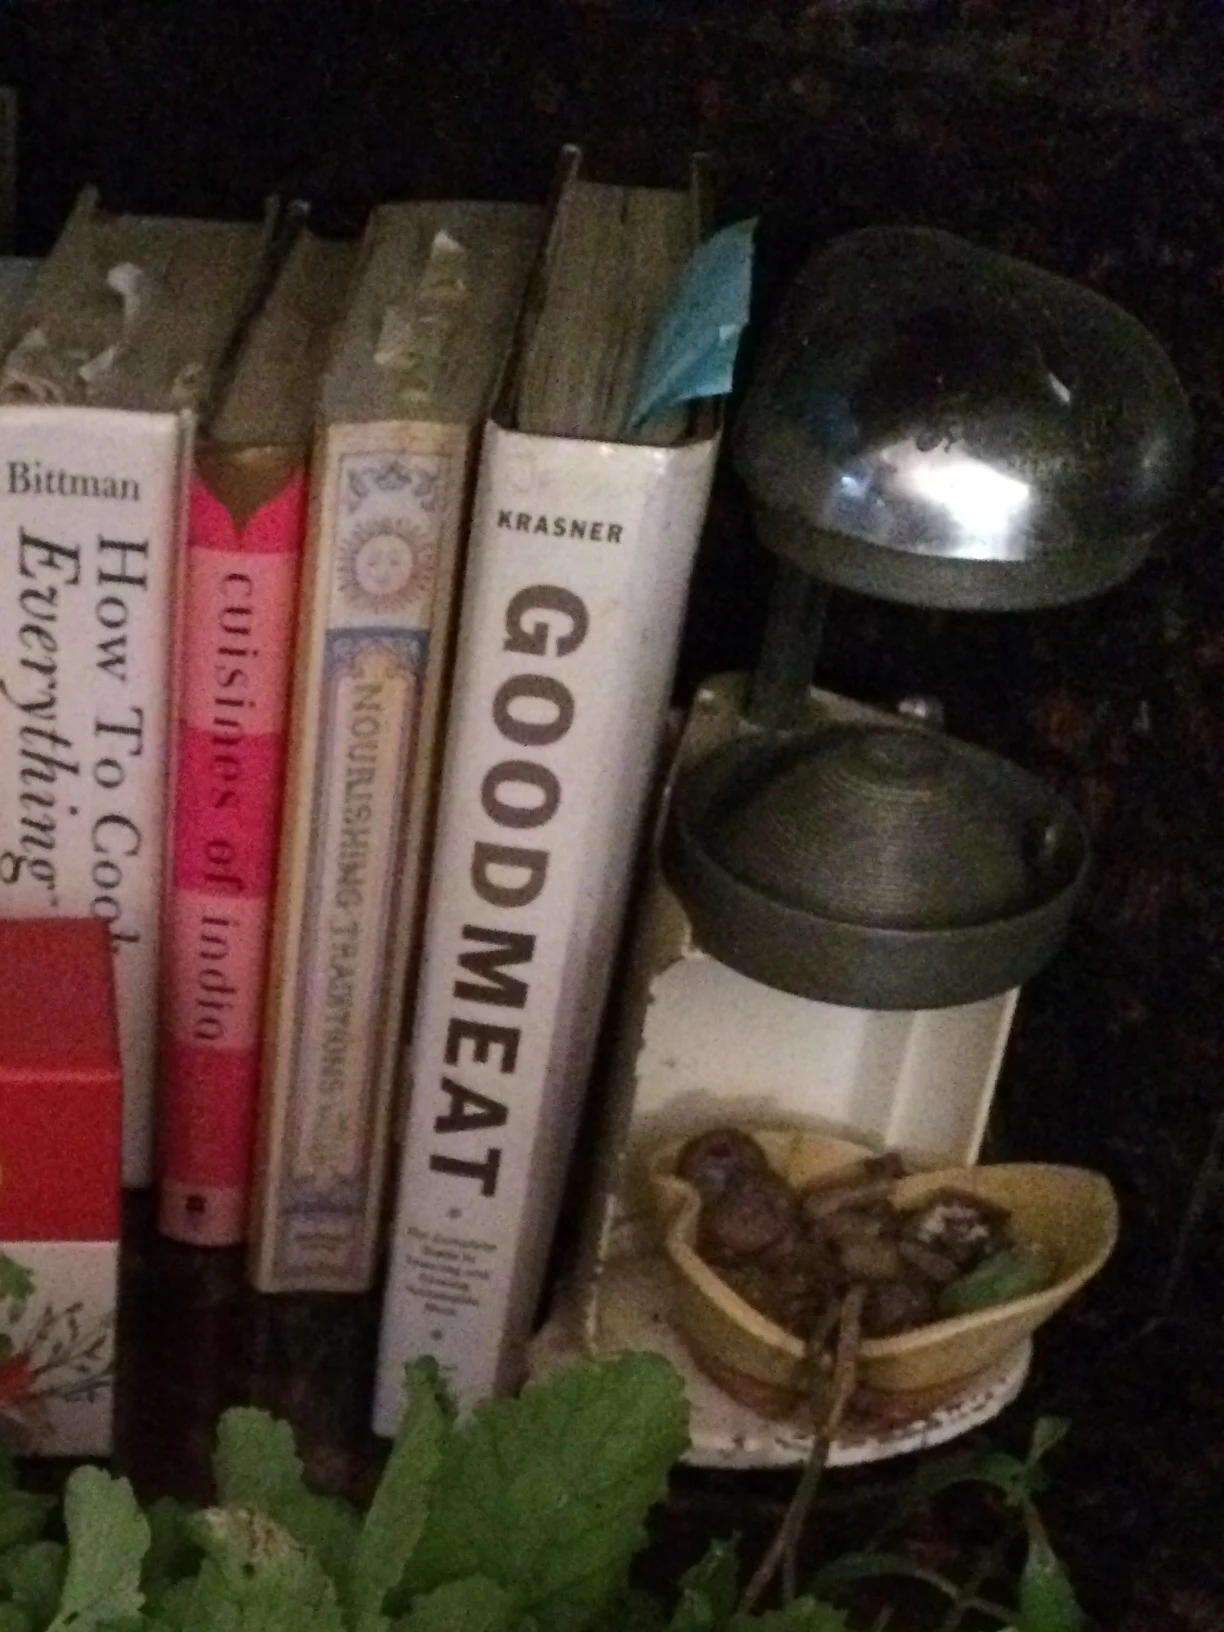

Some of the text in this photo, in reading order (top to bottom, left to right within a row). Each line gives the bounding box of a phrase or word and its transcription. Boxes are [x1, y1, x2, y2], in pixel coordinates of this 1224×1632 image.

[8, 461, 141, 502] Bittman
[495, 507, 625, 544] KRASNER
[93, 534, 149, 681] How
[92, 706, 145, 789] To
[192, 573, 264, 1040] cuisines of india
[318, 680, 384, 1095] NOURISHING TRADITIONS
